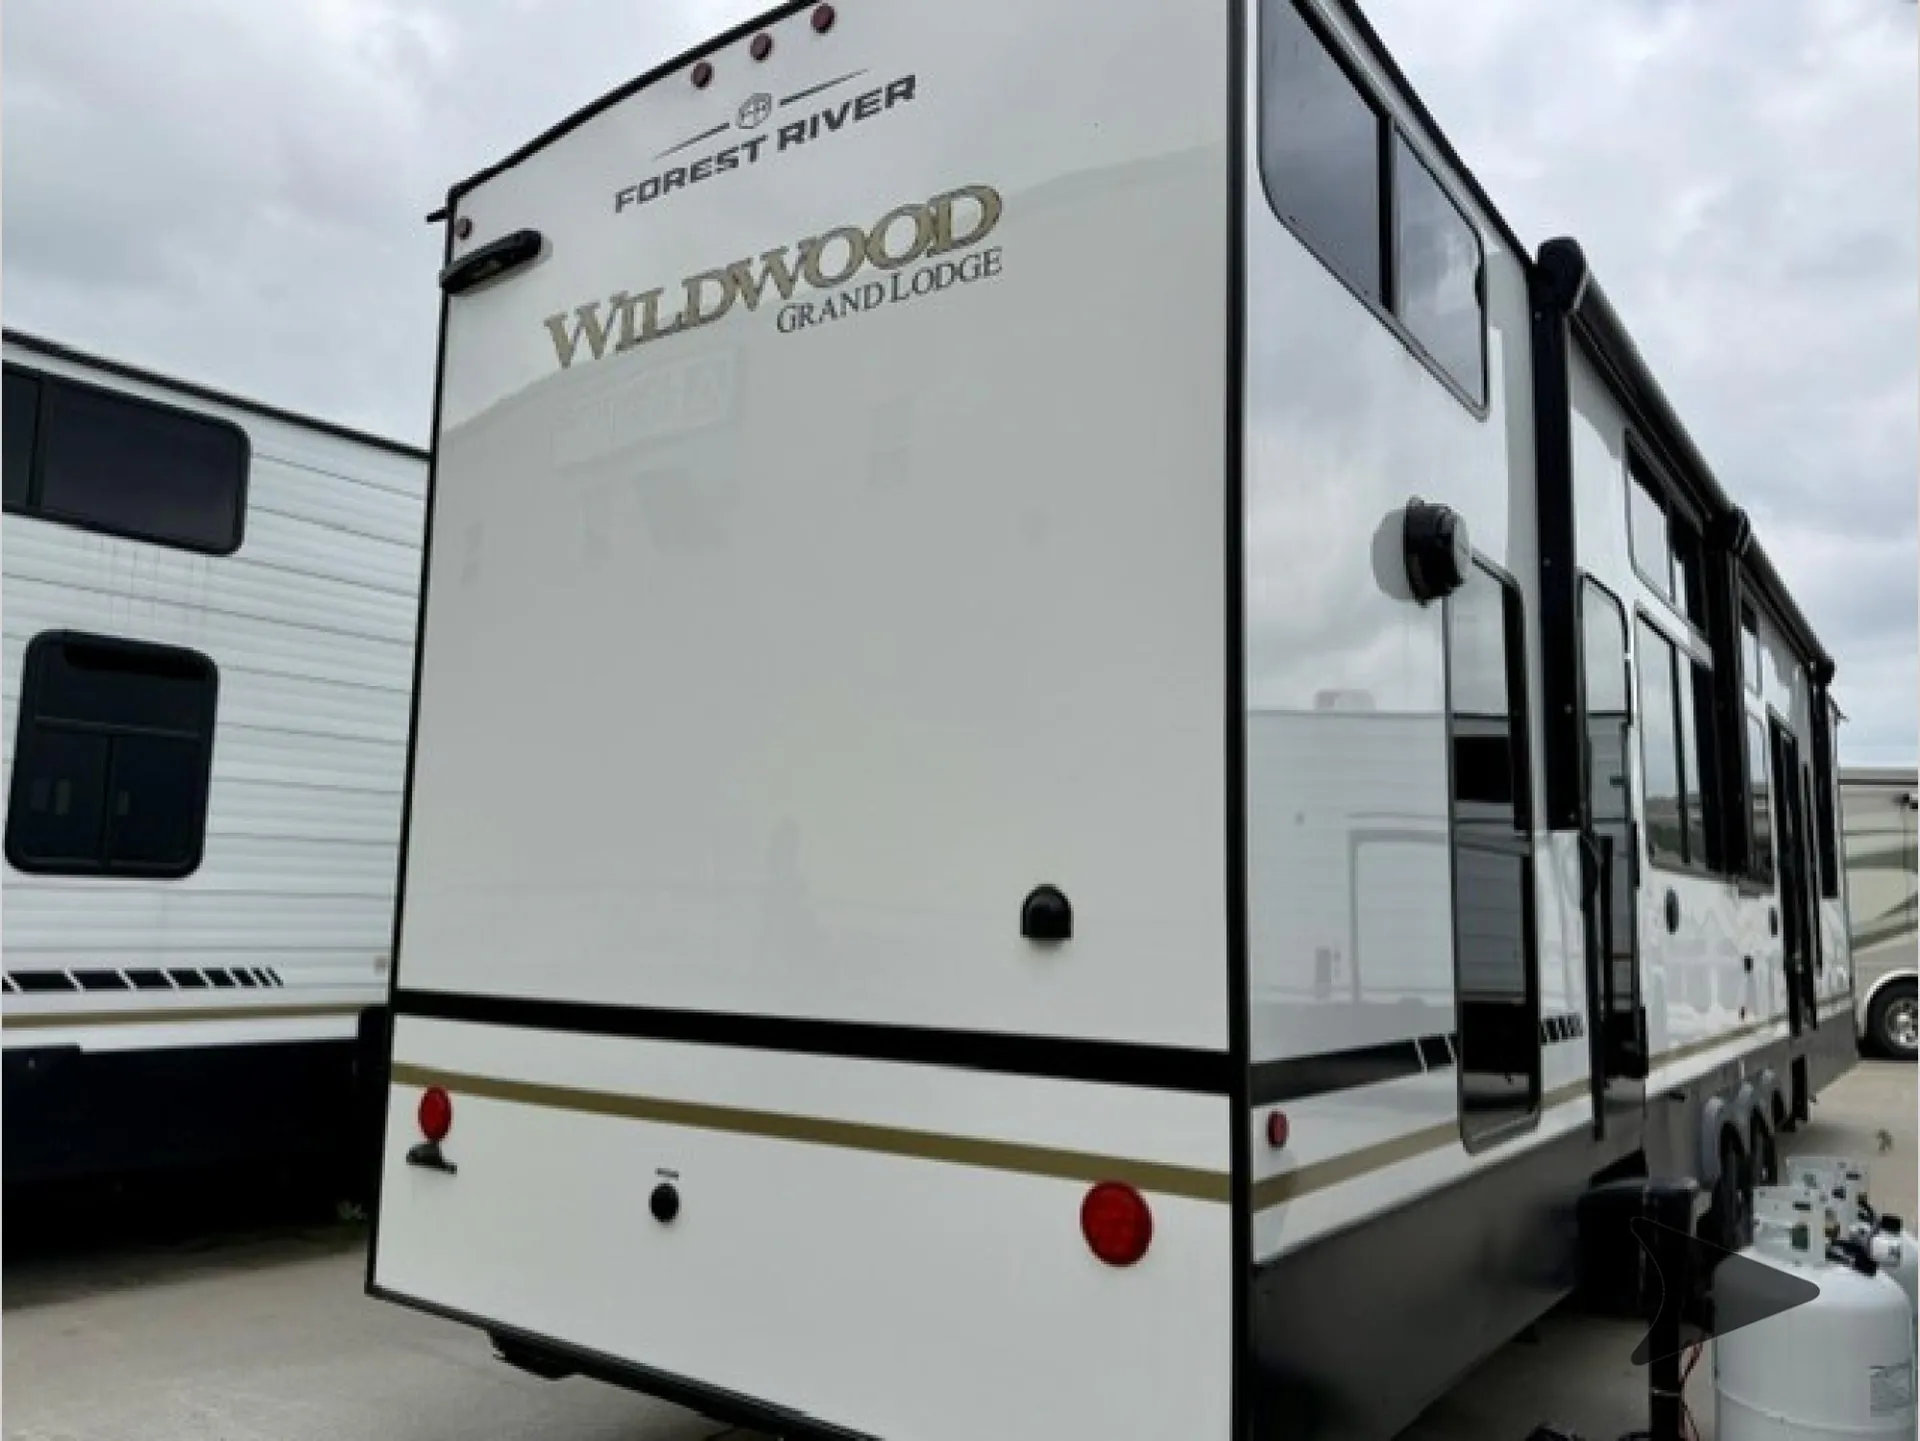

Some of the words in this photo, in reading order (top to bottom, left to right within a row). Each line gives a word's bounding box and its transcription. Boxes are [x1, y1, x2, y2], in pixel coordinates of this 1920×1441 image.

[614, 134, 769, 213] FOREST
[776, 74, 917, 152] RIVER
[543, 184, 1003, 369] WILDWOOD
[776, 281, 886, 334] GRAND
[890, 246, 1003, 302] LODGE
